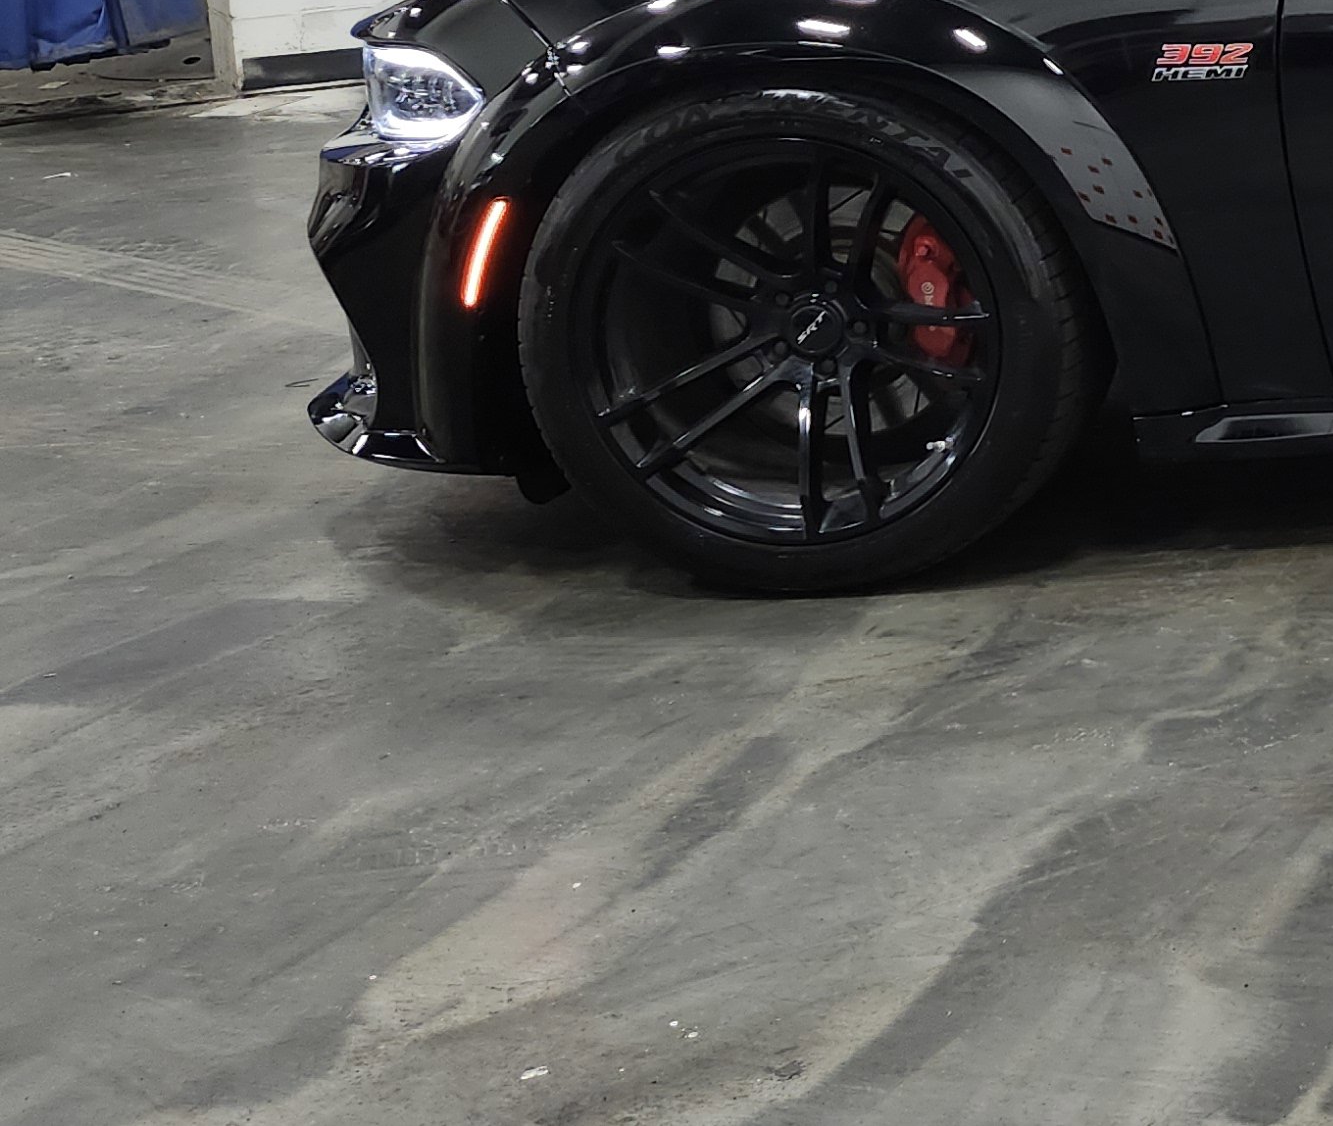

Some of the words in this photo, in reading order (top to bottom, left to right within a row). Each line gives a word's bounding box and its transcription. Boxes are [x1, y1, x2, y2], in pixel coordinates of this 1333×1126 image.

[1156, 43, 1254, 65] 392
[1152, 64, 1249, 82] HEMI
[797, 310, 827, 344] SRT
